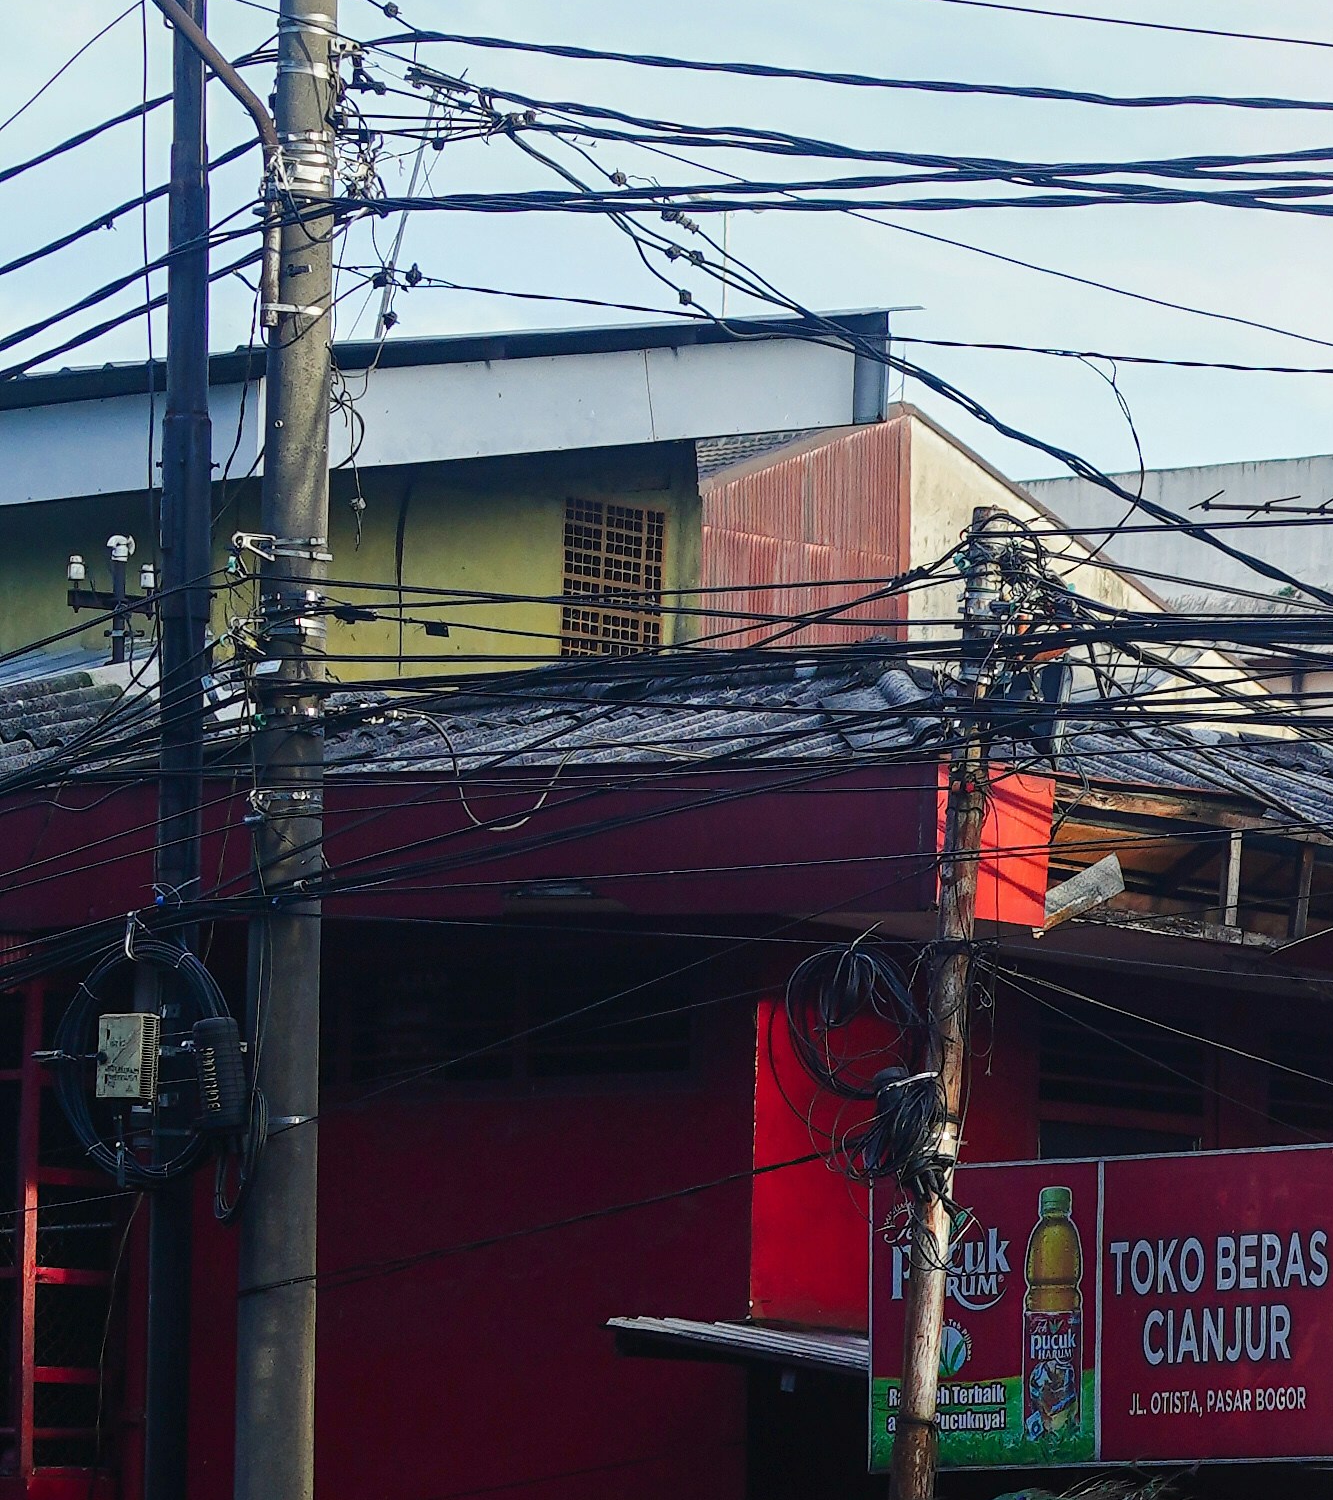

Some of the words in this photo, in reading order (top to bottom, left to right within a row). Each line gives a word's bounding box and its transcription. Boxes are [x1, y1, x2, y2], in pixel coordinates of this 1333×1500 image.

[891, 1227, 1011, 1300] pcuk
[1110, 1237, 1205, 1295] TOKO
[1216, 1230, 1329, 1291] BERAS
[1030, 1328, 1077, 1360] pucuk
[1143, 1304, 1291, 1365] CIANJUR
[952, 1384, 1005, 1404] Terbaik
[1129, 1392, 1147, 1416] JL.
[1151, 1390, 1203, 1418] OTISTA,
[1207, 1389, 1252, 1412] PASAR
[1256, 1386, 1306, 1411] BOGOR
